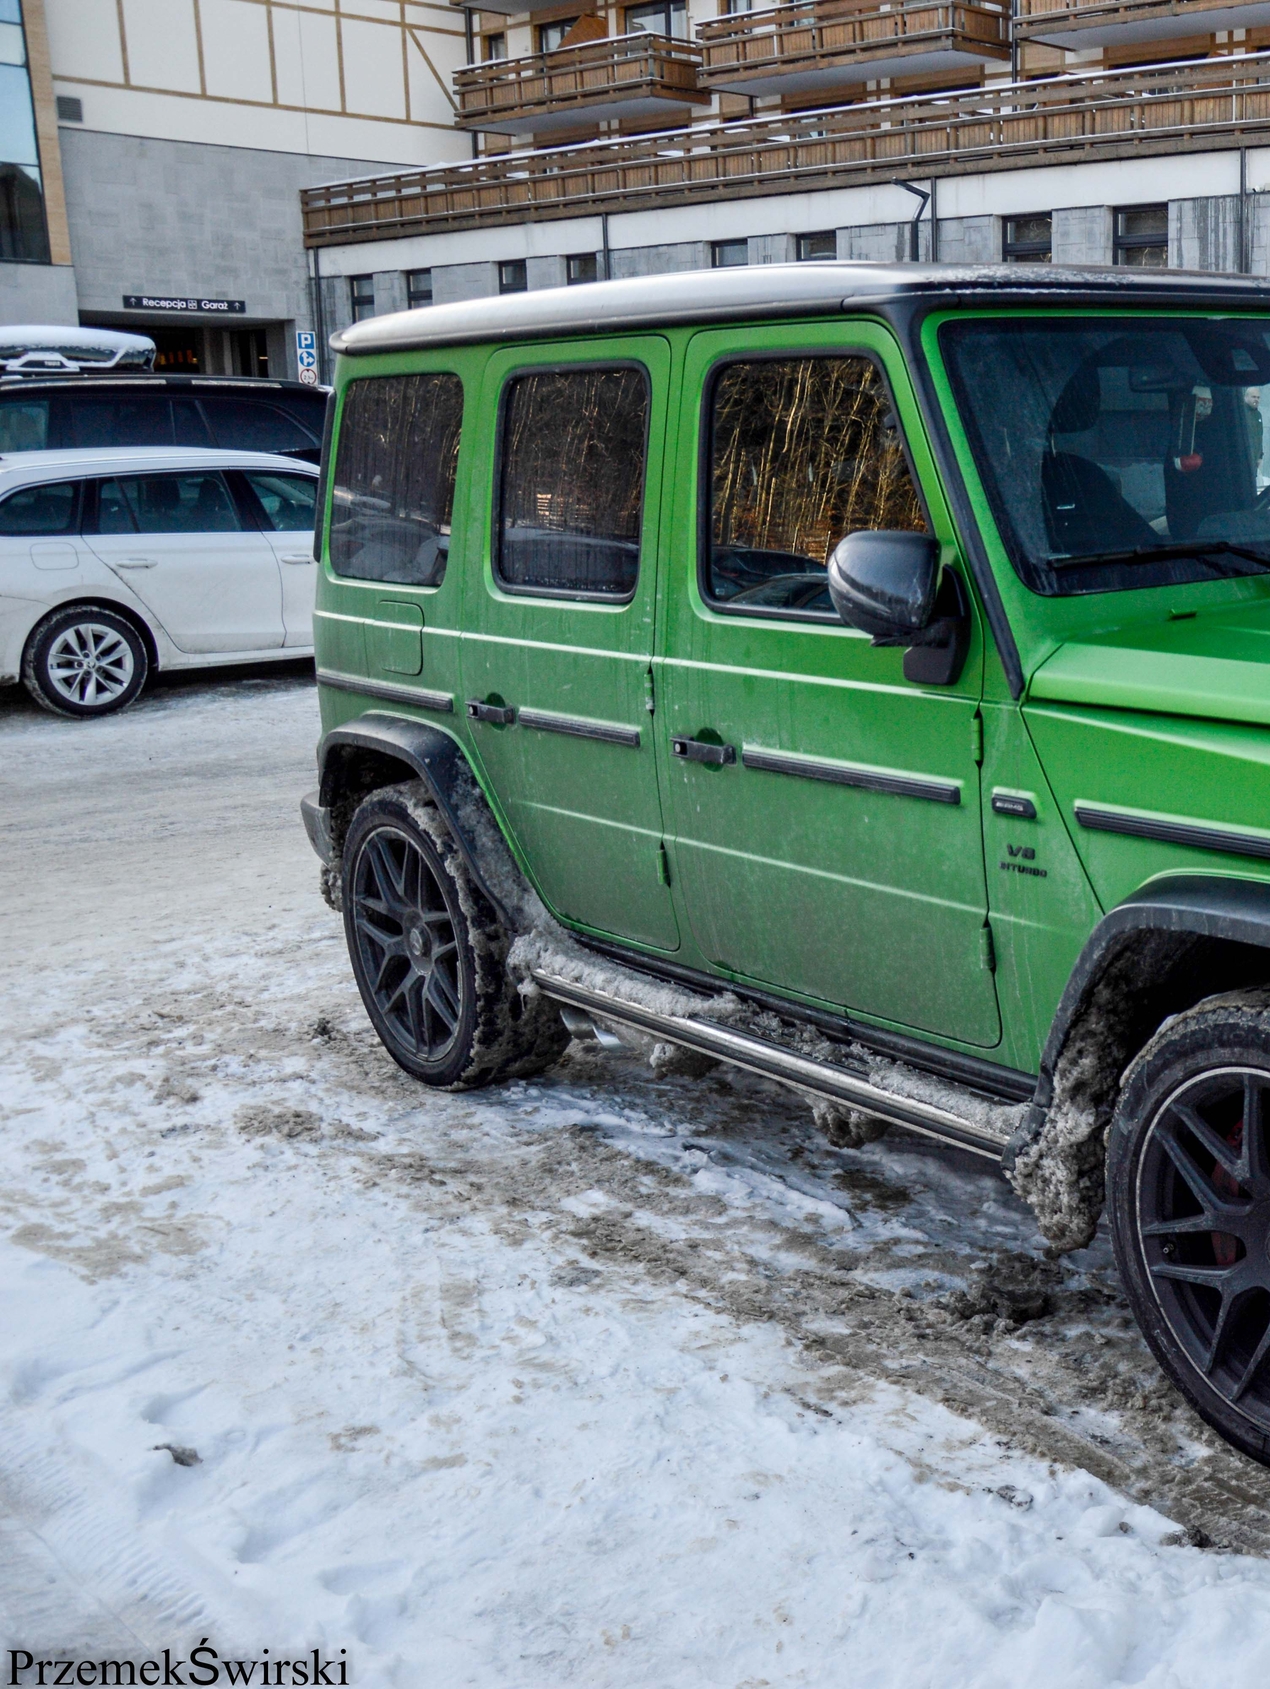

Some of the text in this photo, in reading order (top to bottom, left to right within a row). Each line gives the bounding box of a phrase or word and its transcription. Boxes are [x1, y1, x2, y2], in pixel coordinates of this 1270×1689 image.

[142, 298, 228, 310] Recepcja Garaż
[300, 333, 312, 348] P
[1006, 843, 1035, 860] V8
[999, 861, 1047, 877] BITURBO
